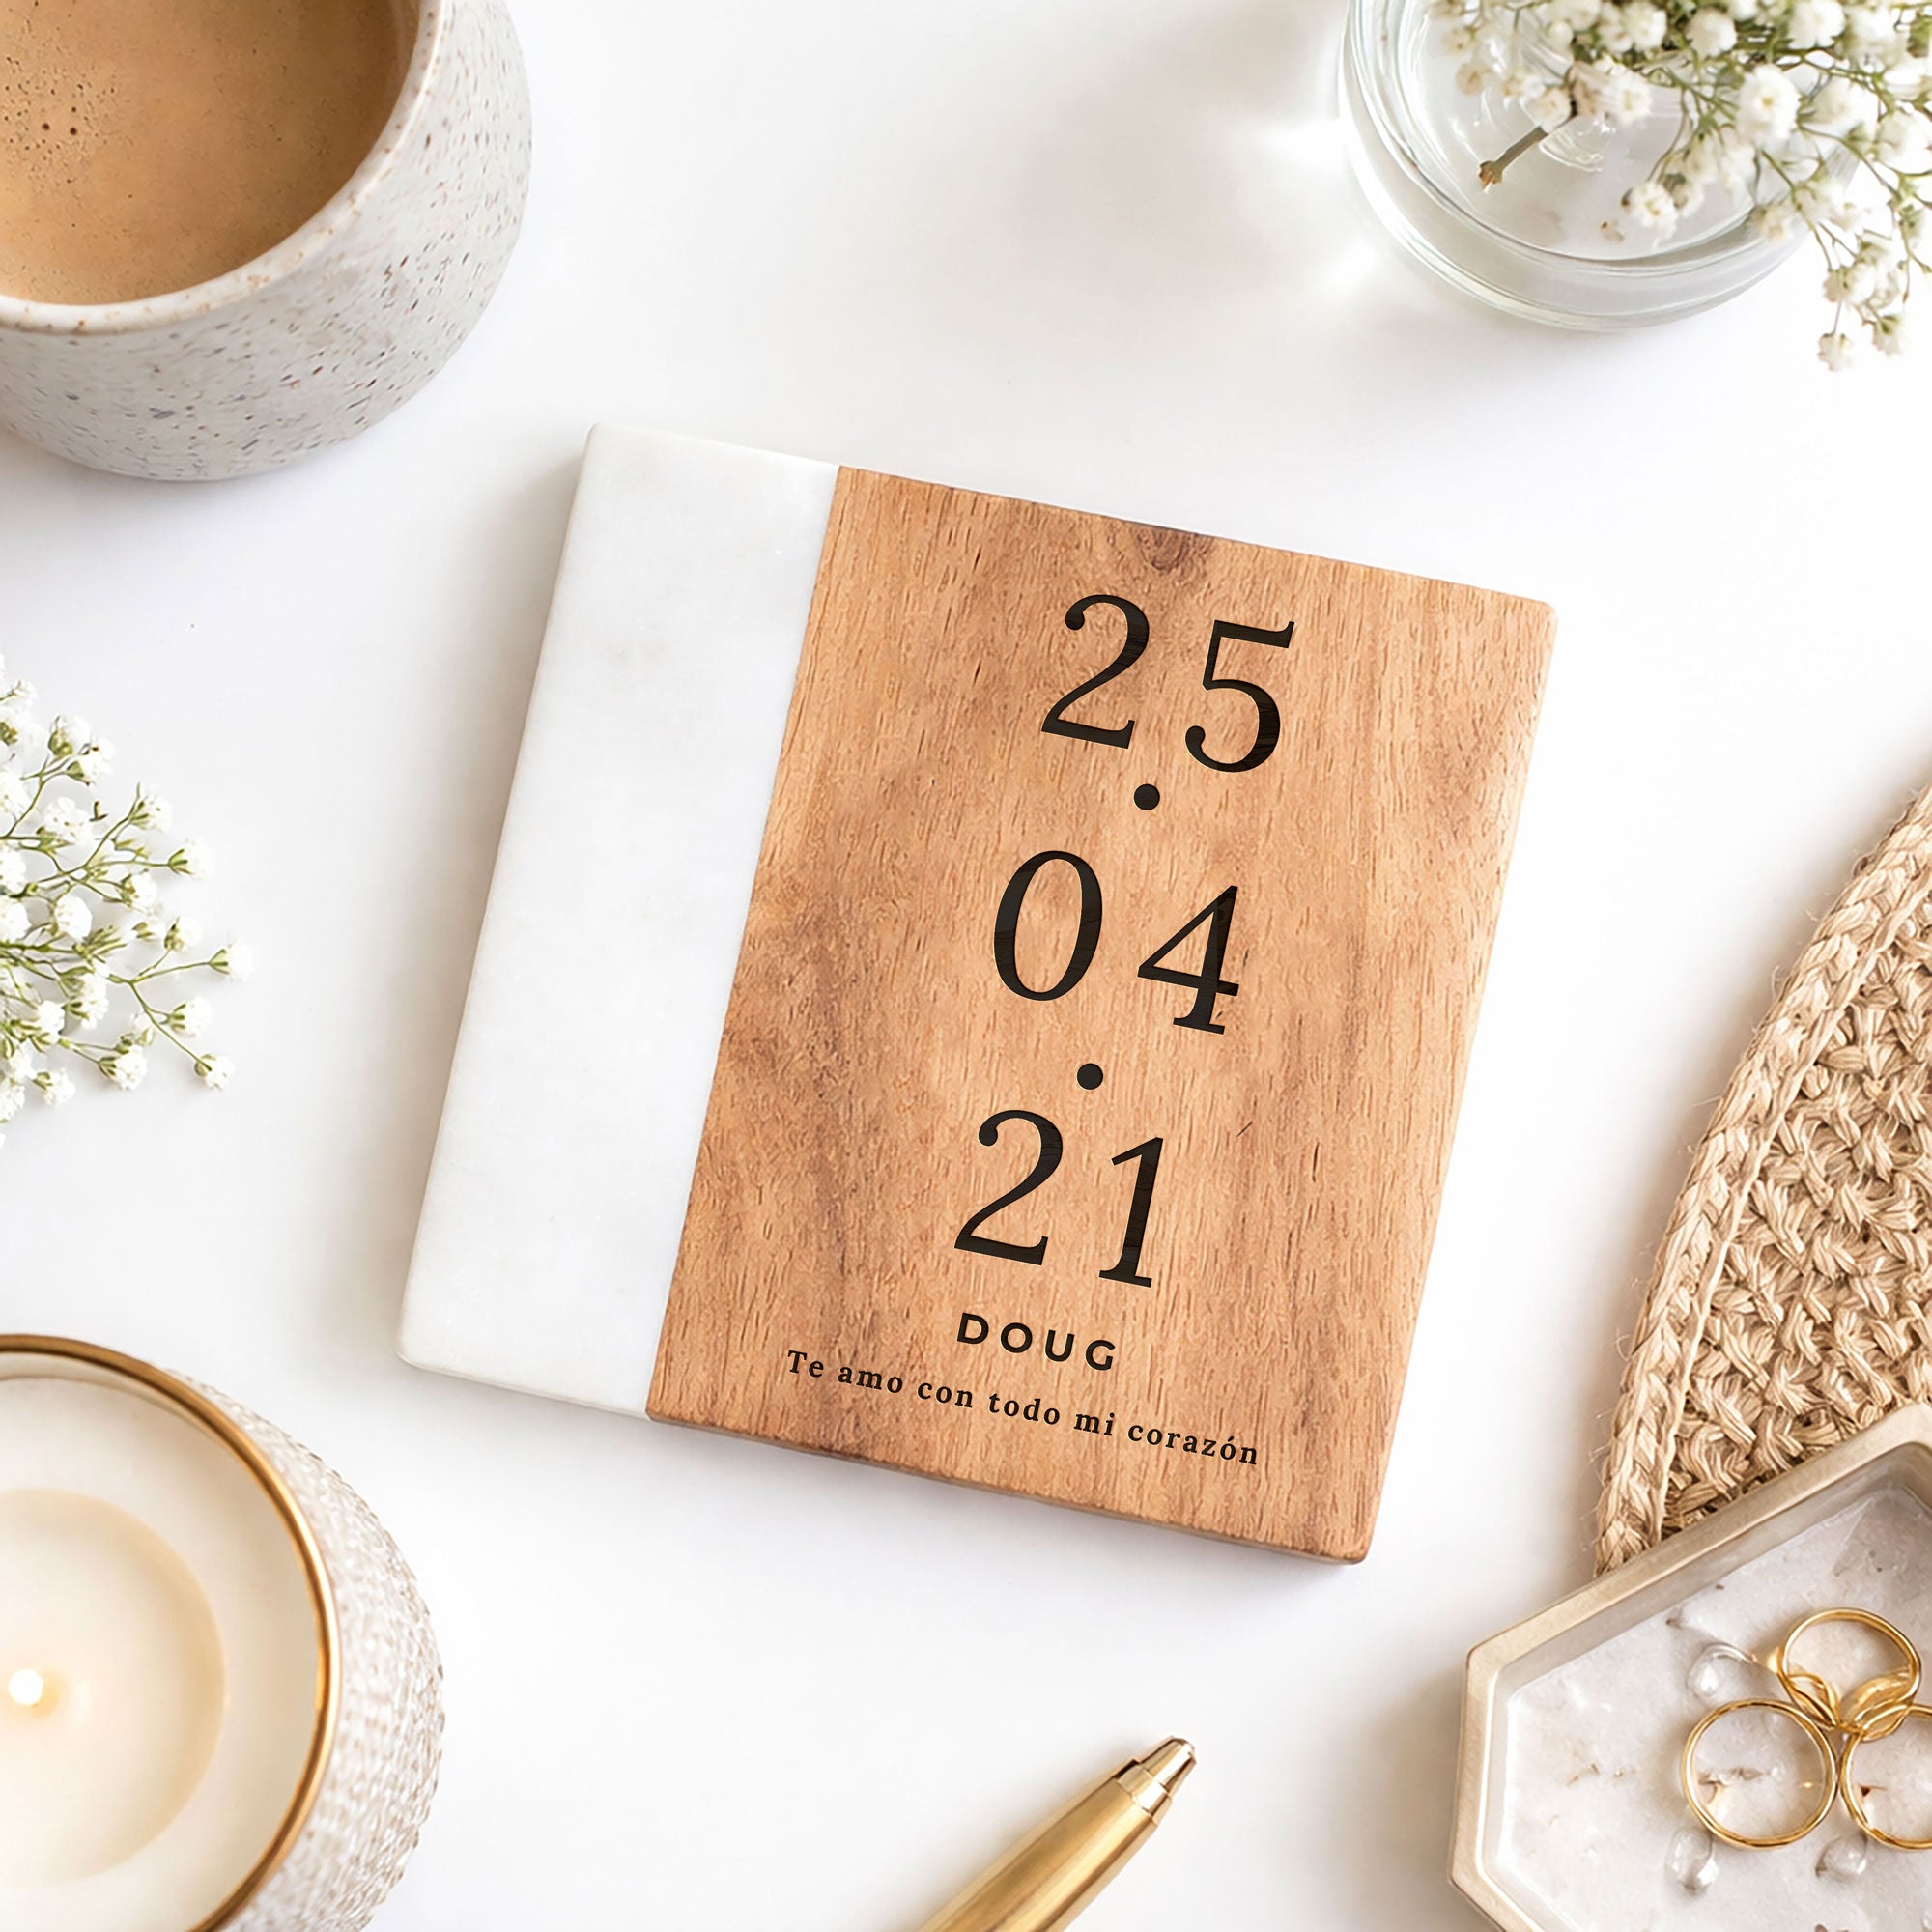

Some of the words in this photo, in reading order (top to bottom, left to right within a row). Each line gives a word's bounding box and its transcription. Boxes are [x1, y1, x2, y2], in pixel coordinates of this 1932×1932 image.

[1040, 593, 1295, 773] 25
[993, 849, 1240, 1035] 04
[953, 1108, 1164, 1288] 21
[787, 1350, 825, 1378] Te
[838, 1366, 903, 1394] amo
[917, 1382, 974, 1408] con
[988, 1393, 1061, 1425] todo
[1073, 1412, 1115, 1436] mi
[1127, 1425, 1259, 1465] corazón
[956, 1312, 1116, 1371] DOUG
